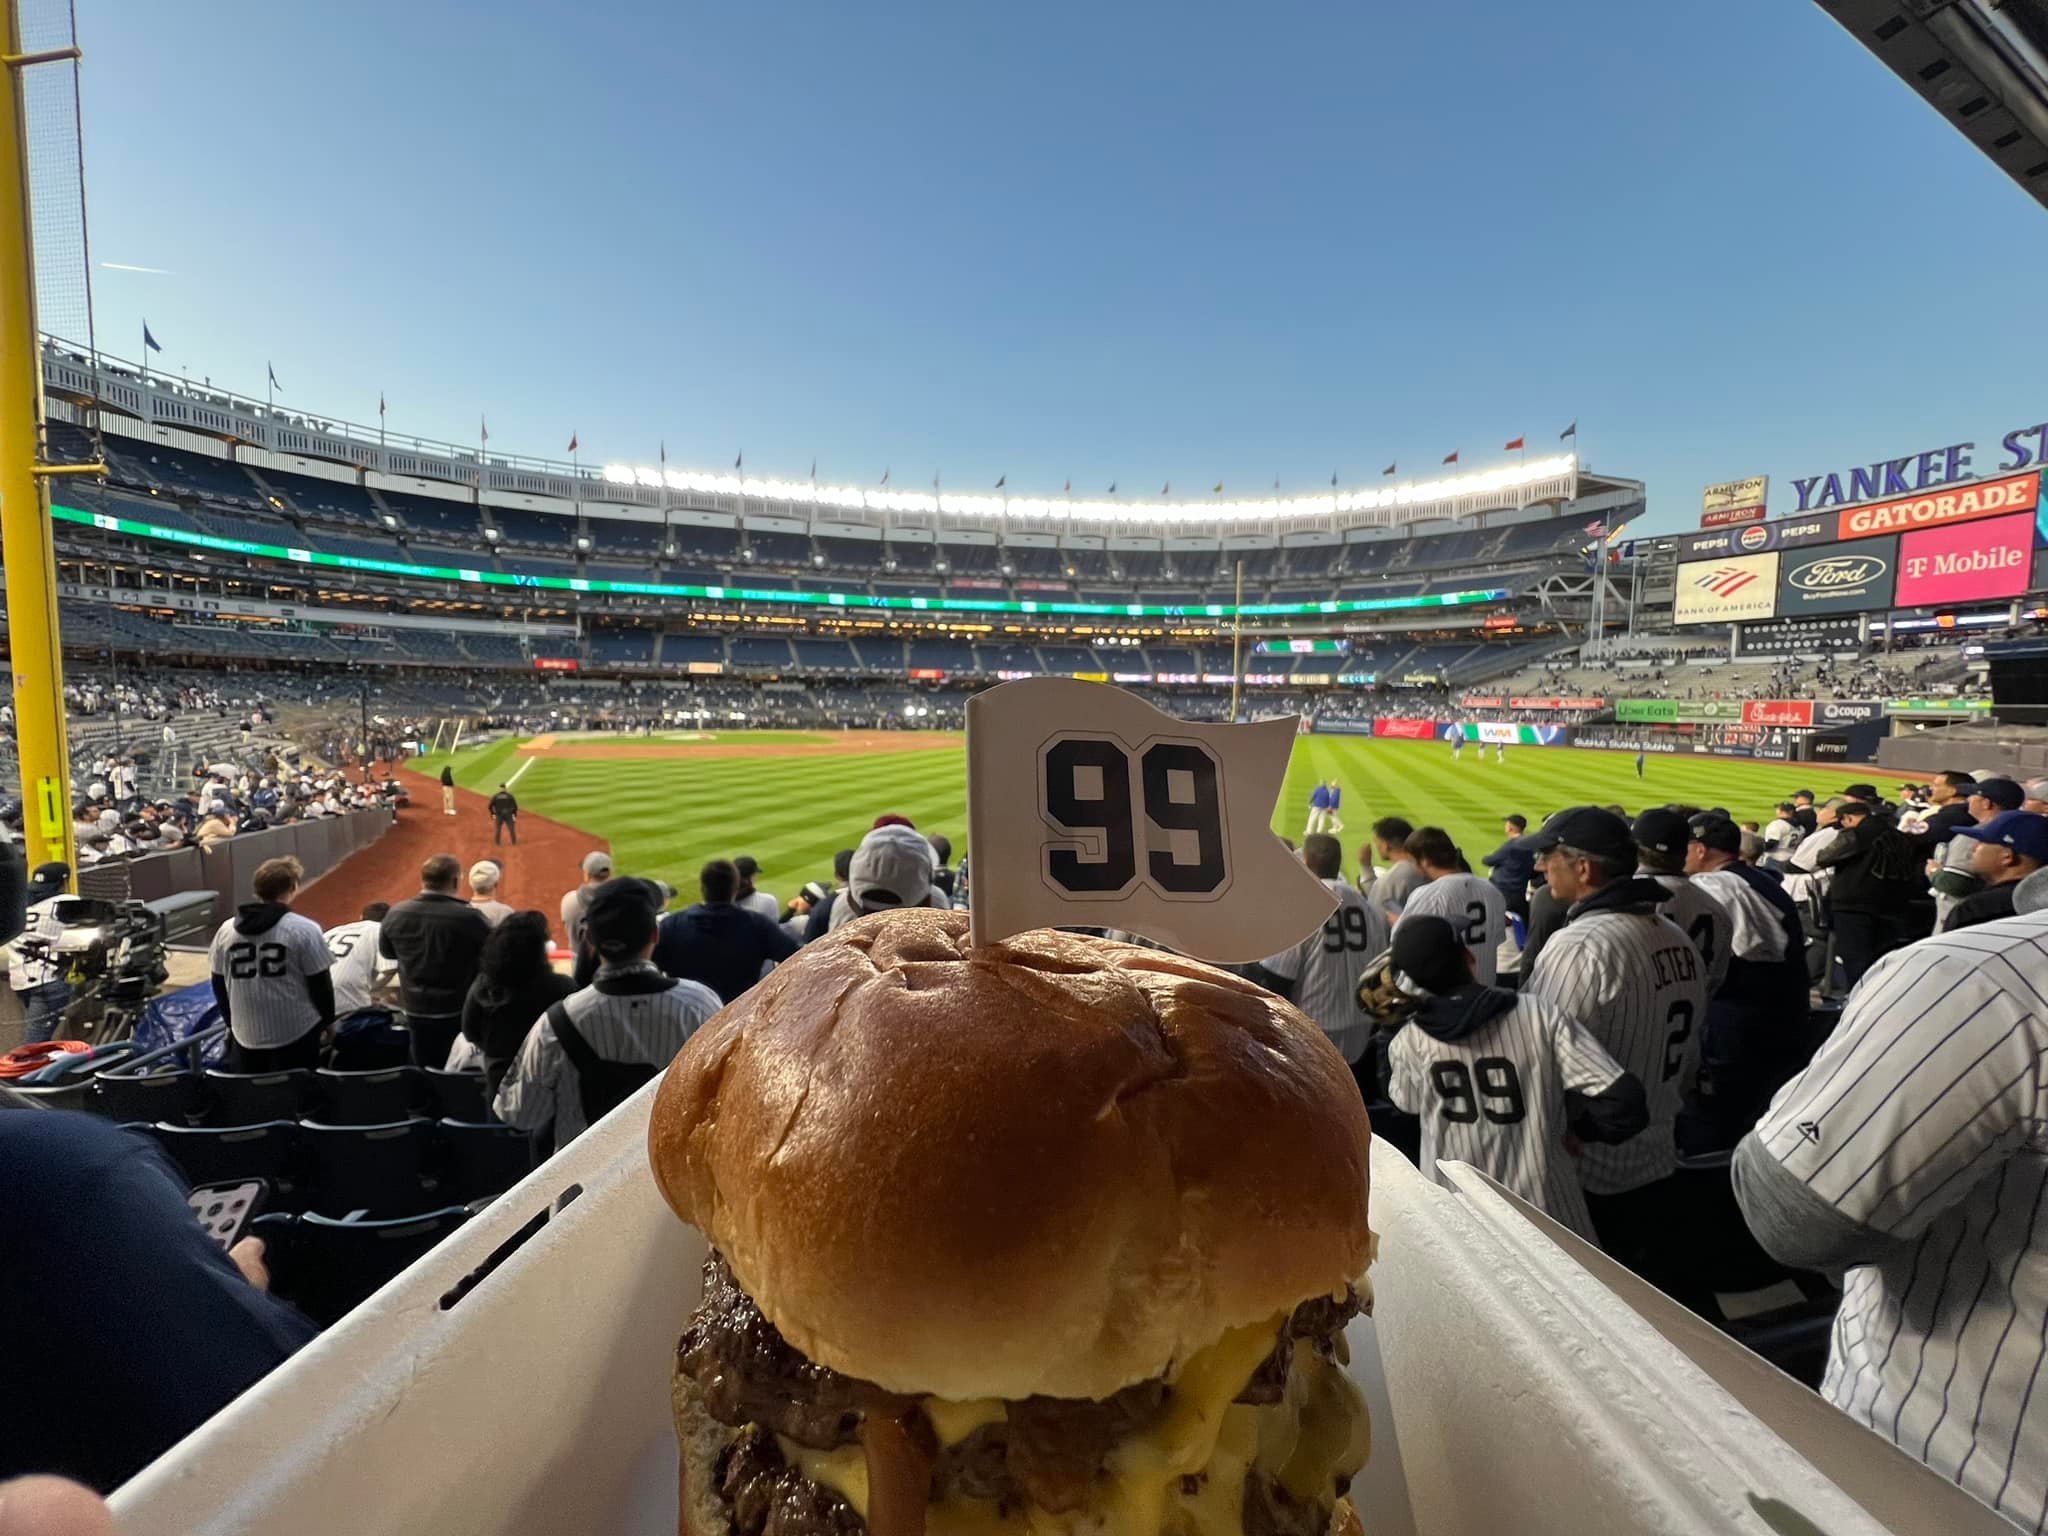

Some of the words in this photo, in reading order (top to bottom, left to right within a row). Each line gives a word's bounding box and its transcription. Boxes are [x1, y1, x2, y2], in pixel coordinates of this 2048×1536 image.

[1705, 480, 1762, 496] ARMITRON
[1790, 442, 1975, 512] YANKEE
[1706, 508, 1757, 521] ARMITRON
[1849, 480, 2029, 532] GATORADE
[1693, 538, 1728, 551] PEPSI
[1782, 524, 1820, 538] PEPSI
[1804, 560, 1868, 585] Ford
[1932, 546, 2022, 576] Mobile
[1677, 607, 1704, 615] BANK
[1708, 606, 1720, 614] OF
[1722, 602, 1771, 612] AMERICA
[1648, 702, 1674, 716] Eats
[1839, 705, 1871, 718] coupa
[1045, 738, 1226, 893] 99
[1323, 906, 1367, 953] 99
[1466, 902, 1486, 944] 2
[229, 941, 288, 979] 22
[328, 934, 361, 957] 5
[1651, 946, 1697, 991] JETER
[1661, 1000, 1694, 1083] 2
[1430, 1056, 1526, 1125] 99
